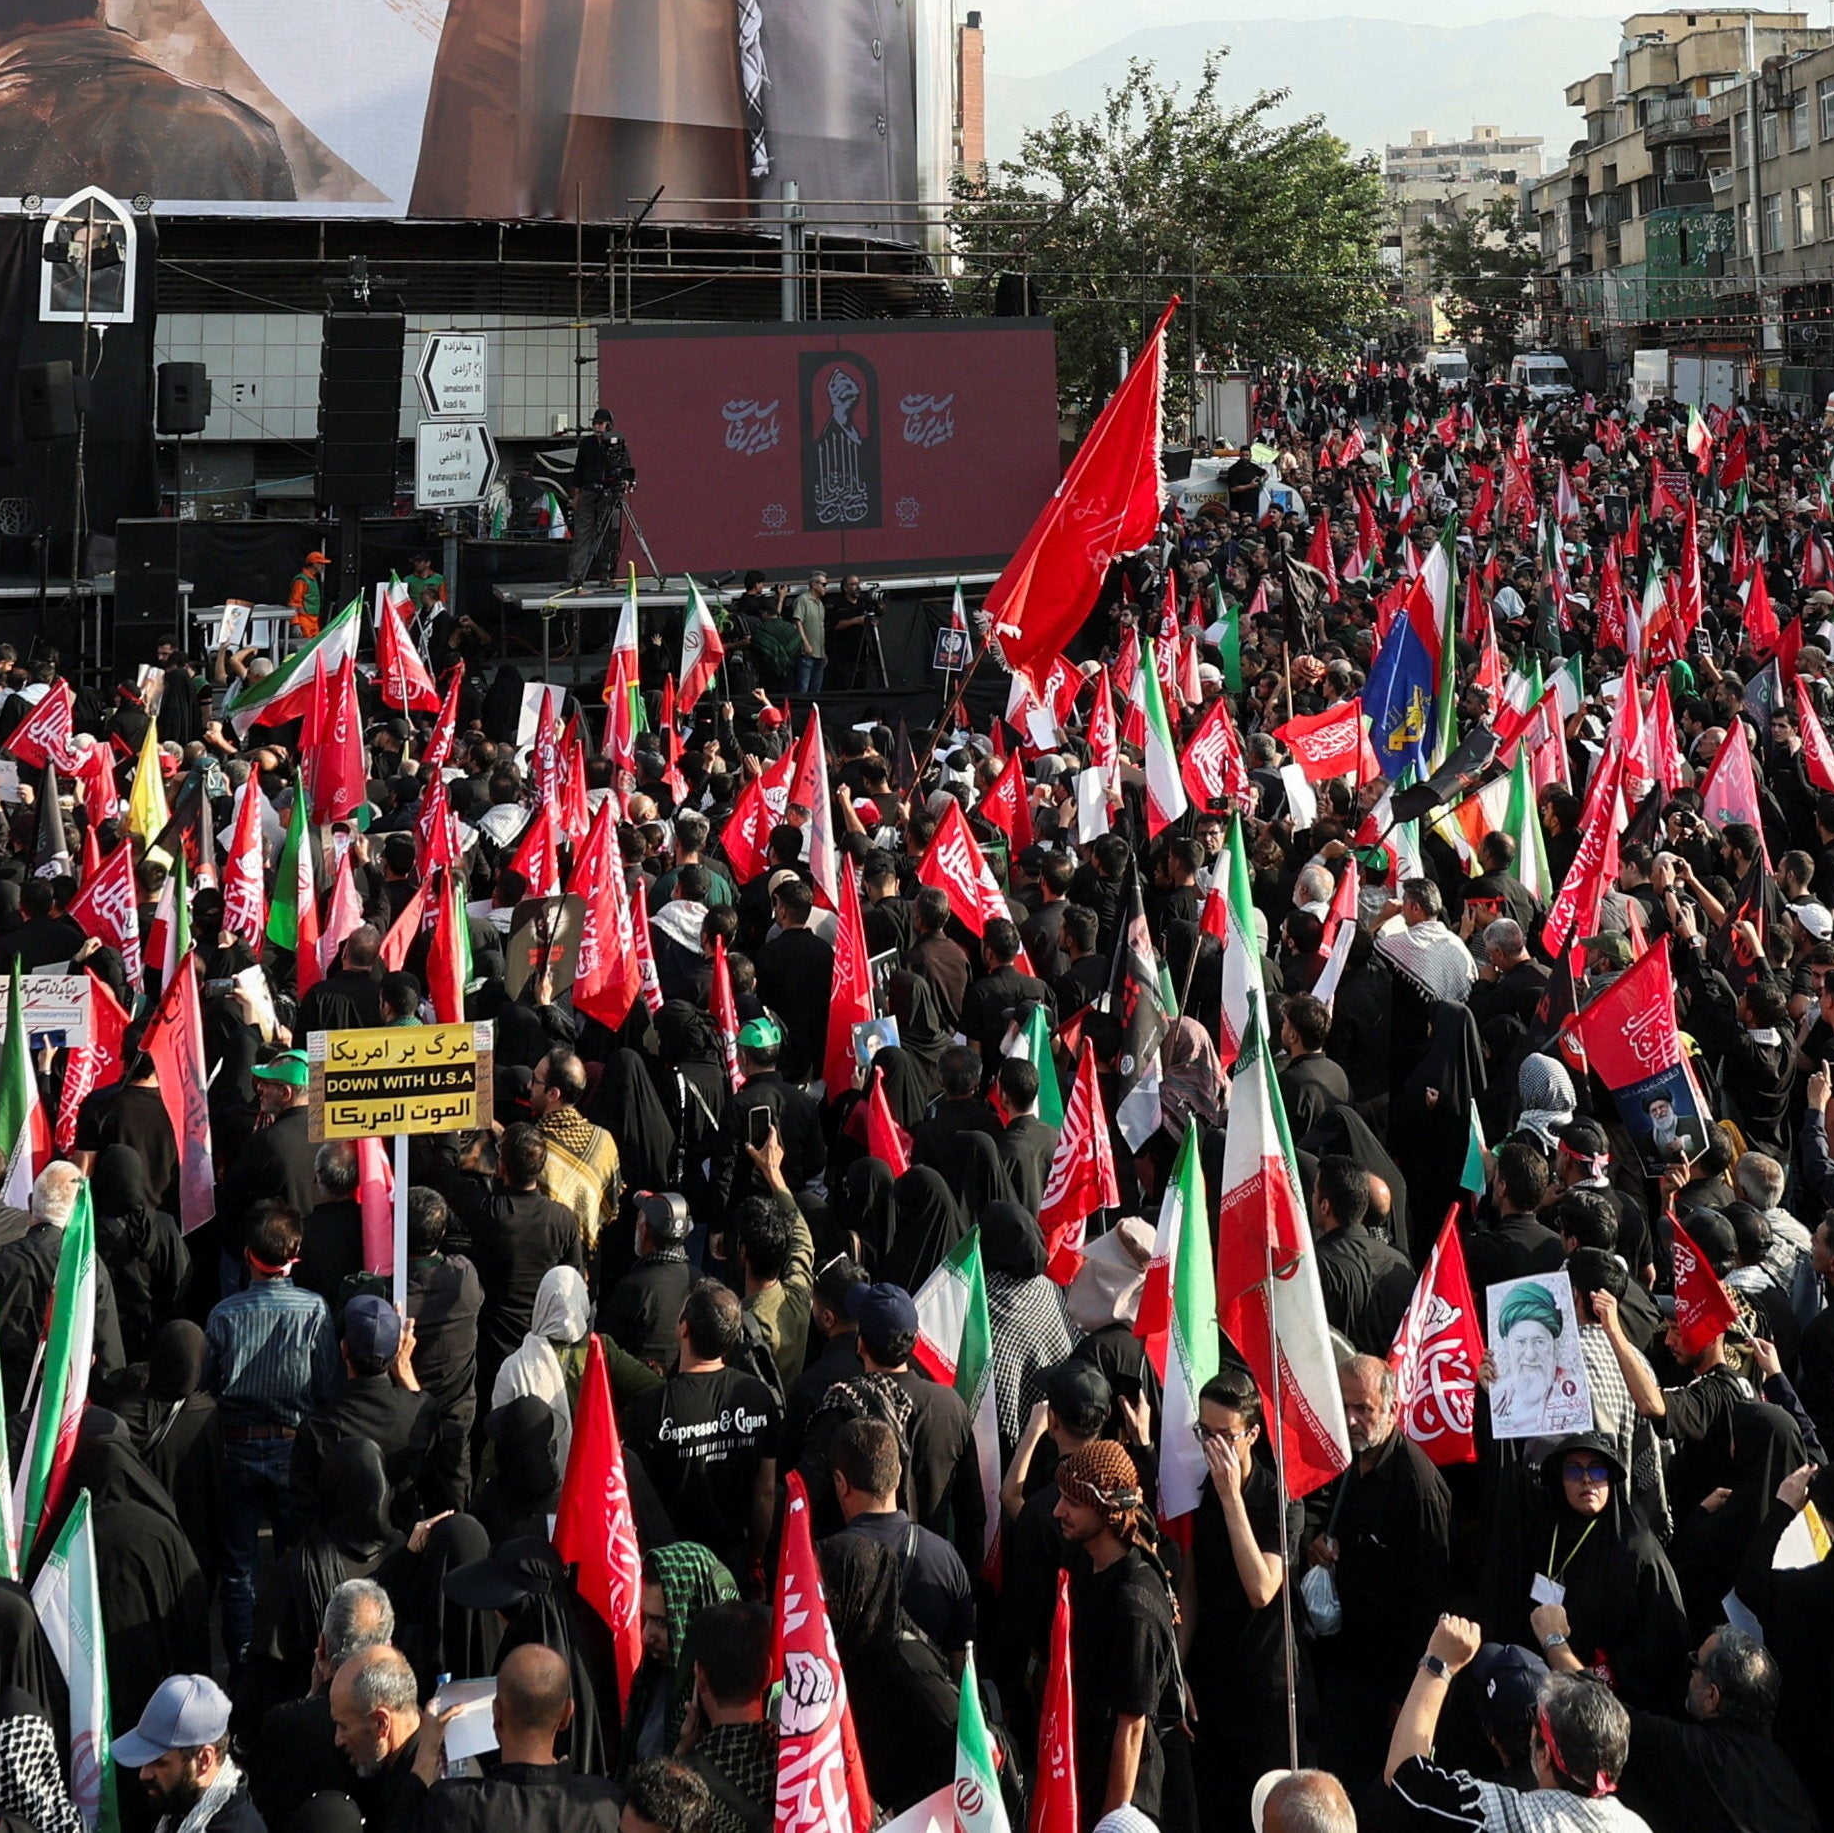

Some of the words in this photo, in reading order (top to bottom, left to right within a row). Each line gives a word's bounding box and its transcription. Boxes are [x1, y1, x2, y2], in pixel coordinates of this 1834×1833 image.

[452, 362, 472, 377] آزادی
[439, 450, 462, 465] فاطمی
[330, 1039, 389, 1067] امریکا
[397, 1046, 416, 1064] بر
[425, 1032, 470, 1060] مرگ
[327, 1077, 378, 1093] DOWN
[383, 1073, 425, 1090] WITH
[429, 1070, 473, 1086] U.S.A
[330, 1104, 406, 1130] لامریکا
[411, 1098, 470, 1125] الموت
[658, 1417, 719, 1446] Espresso
[719, 1409, 733, 1432] &
[734, 1406, 768, 1434] Cigars
